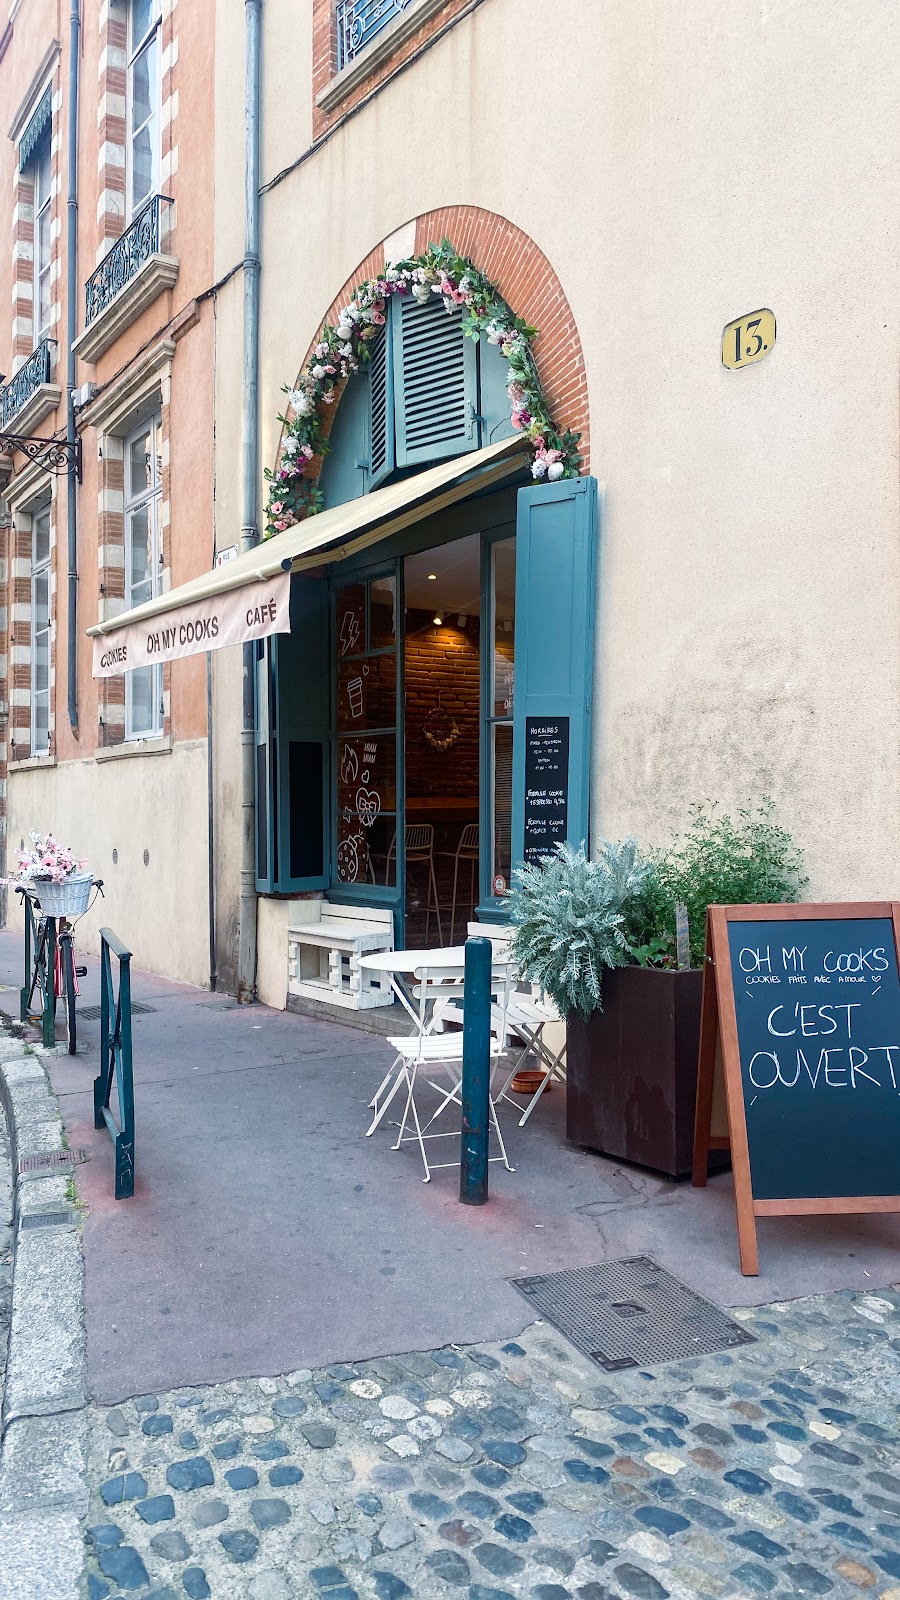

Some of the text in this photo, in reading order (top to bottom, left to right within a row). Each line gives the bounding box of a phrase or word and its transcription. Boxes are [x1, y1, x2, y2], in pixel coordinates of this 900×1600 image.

[246, 597, 277, 628] CAFÉ
[146, 615, 219, 655] OH MY COOKS
[100, 645, 128, 668] COOKIES
[739, 945, 889, 973] OH MY COOKS
[745, 975, 781, 985] COOKIES
[813, 975, 832, 984] AVEC
[838, 975, 867, 984] AMOUR
[767, 1001, 862, 1039] C'EST
[749, 1045, 900, 1089] OUVERT
